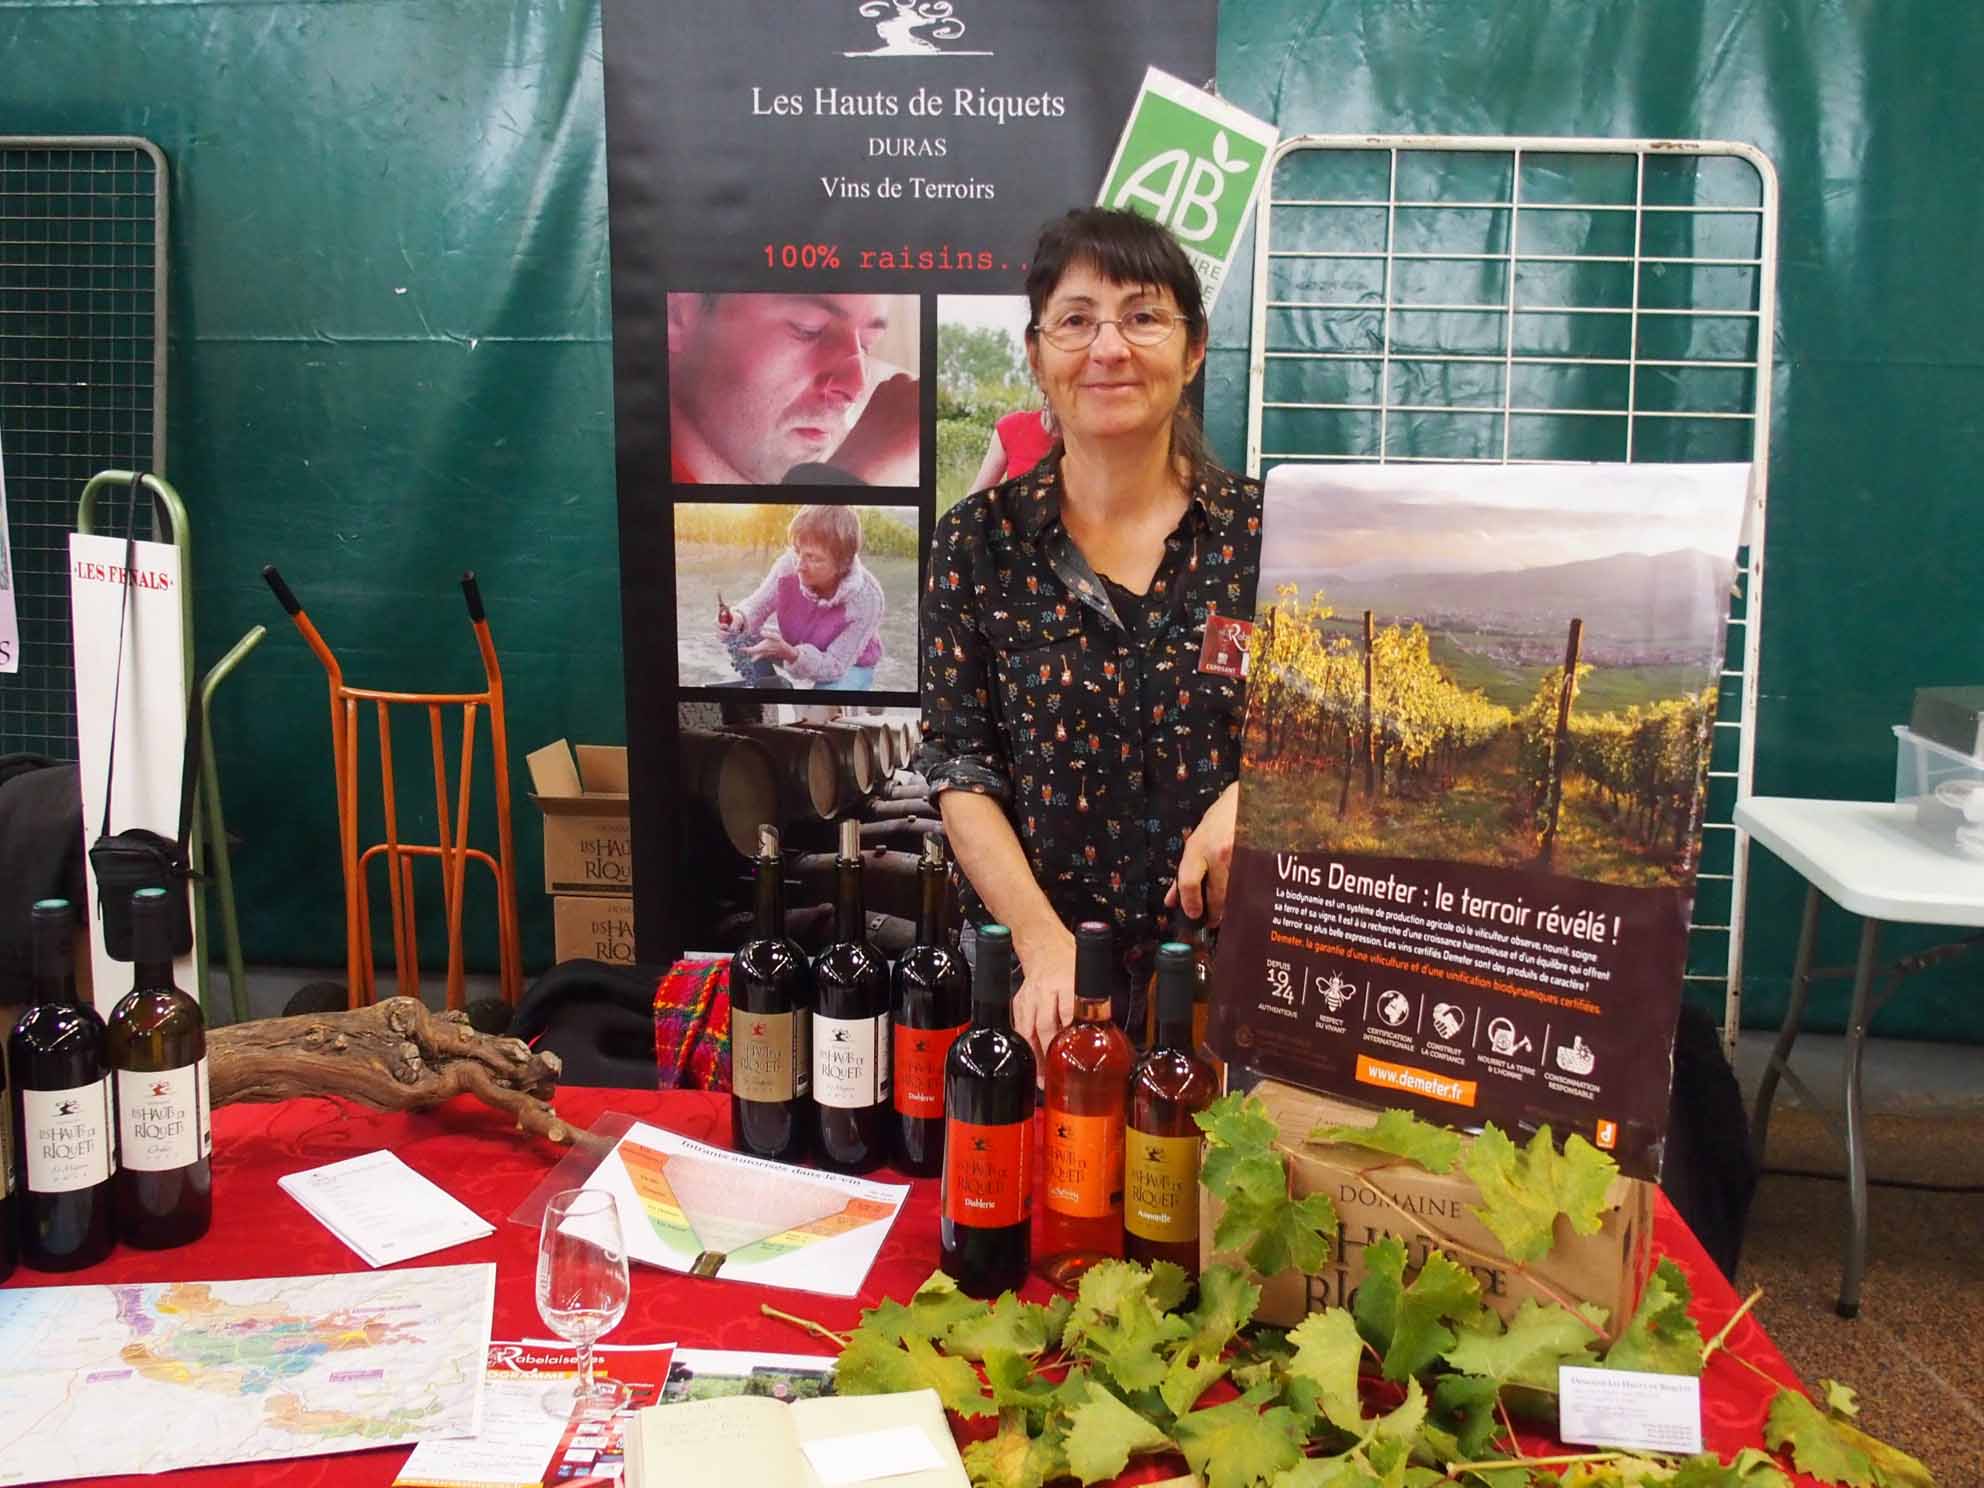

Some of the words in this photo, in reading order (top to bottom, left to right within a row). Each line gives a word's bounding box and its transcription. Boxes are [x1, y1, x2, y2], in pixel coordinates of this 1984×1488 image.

[752, 87, 804, 116] Les
[814, 87, 899, 117] Hauts
[908, 86, 944, 117] de
[953, 86, 1066, 125] Riquets
[868, 137, 947, 158] DURAS
[820, 177, 872, 199] Vins
[877, 177, 902, 199] de
[909, 177, 995, 199] Terroirs
[1113, 148, 1225, 241] AB
[764, 244, 841, 269] 100%
[77, 561, 105, 582] LES
[1277, 853, 1321, 886] Vins
[1328, 862, 1417, 904] Demeter
[1435, 882, 1454, 912] le
[1461, 887, 1531, 926] terroir
[1537, 904, 1606, 943] révélé
[1612, 916, 1620, 945] !
[1276, 887, 1284, 898] La
[1286, 890, 1324, 905] biodynamie
[1325, 897, 1335, 907] est
[1347, 901, 1374, 916] système
[1375, 907, 1385, 917] de
[1386, 909, 1425, 926] production
[1426, 919, 1454, 931] agricole
[1456, 924, 1465, 934] où
[1466, 925, 1473, 935] le
[1475, 928, 1510, 942] viticulteur
[1571, 949, 1597, 962] soigne
[1274, 903, 1283, 912] sa
[1284, 903, 1299, 915] terre
[1300, 906, 1307, 916] et
[1308, 910, 1317, 918] sa
[1343, 915, 1353, 926] est
[1354, 917, 1359, 927] à
[1360, 919, 1367, 928] la
[1367, 920, 1401, 937] recherche
[1402, 928, 1422, 940] d'une
[1423, 933, 1461, 948] croissance
[1463, 940, 1509, 959] harmonieuse
[1509, 951, 1518, 960] et
[1519, 952, 1535, 964] d'un
[1536, 955, 1568, 972] équilibre
[1569, 964, 1581, 975] qui
[1583, 966, 1610, 980] offrent
[1266, 959, 1291, 971] DEPUIS
[1272, 917, 1281, 925] au
[1282, 917, 1303, 930] terroir
[1304, 923, 1313, 932] sa
[1314, 924, 1328, 936] plus
[1328, 926, 1344, 939] belle
[1345, 930, 1382, 947] expression.
[1383, 938, 1396, 949] Les
[1397, 941, 1412, 952] vins
[1414, 945, 1442, 959] certifiés
[1443, 950, 1472, 965] Demeter
[1474, 958, 1491, 970] sont
[1492, 962, 1505, 973] des
[1506, 966, 1538, 981] produits
[1539, 973, 1549, 982] de
[1550, 976, 1585, 992] caractère
[1305, 938, 1313, 950] la
[1314, 941, 1345, 957] garantie
[1370, 952, 1409, 970] viticulture
[1410, 962, 1419, 972] et
[1266, 969, 1289, 988] 19
[1272, 983, 1295, 1005] 24
[1363, 1033, 1415, 1052] INTERNATIONALE
[1367, 1027, 1413, 1043] CERTIFICATION
[1421, 1047, 1429, 1056] LA
[1430, 1049, 1465, 1065] CONFIANCE
[1426, 1041, 1462, 1055] CONSTRUIT
[1506, 1062, 1515, 1070] LA
[1368, 1065, 1463, 1100] www.demeter.fr
[1549, 1081, 1594, 1101] RESPONSABLE
[1339, 1184, 1463, 1219] DOMAINE
